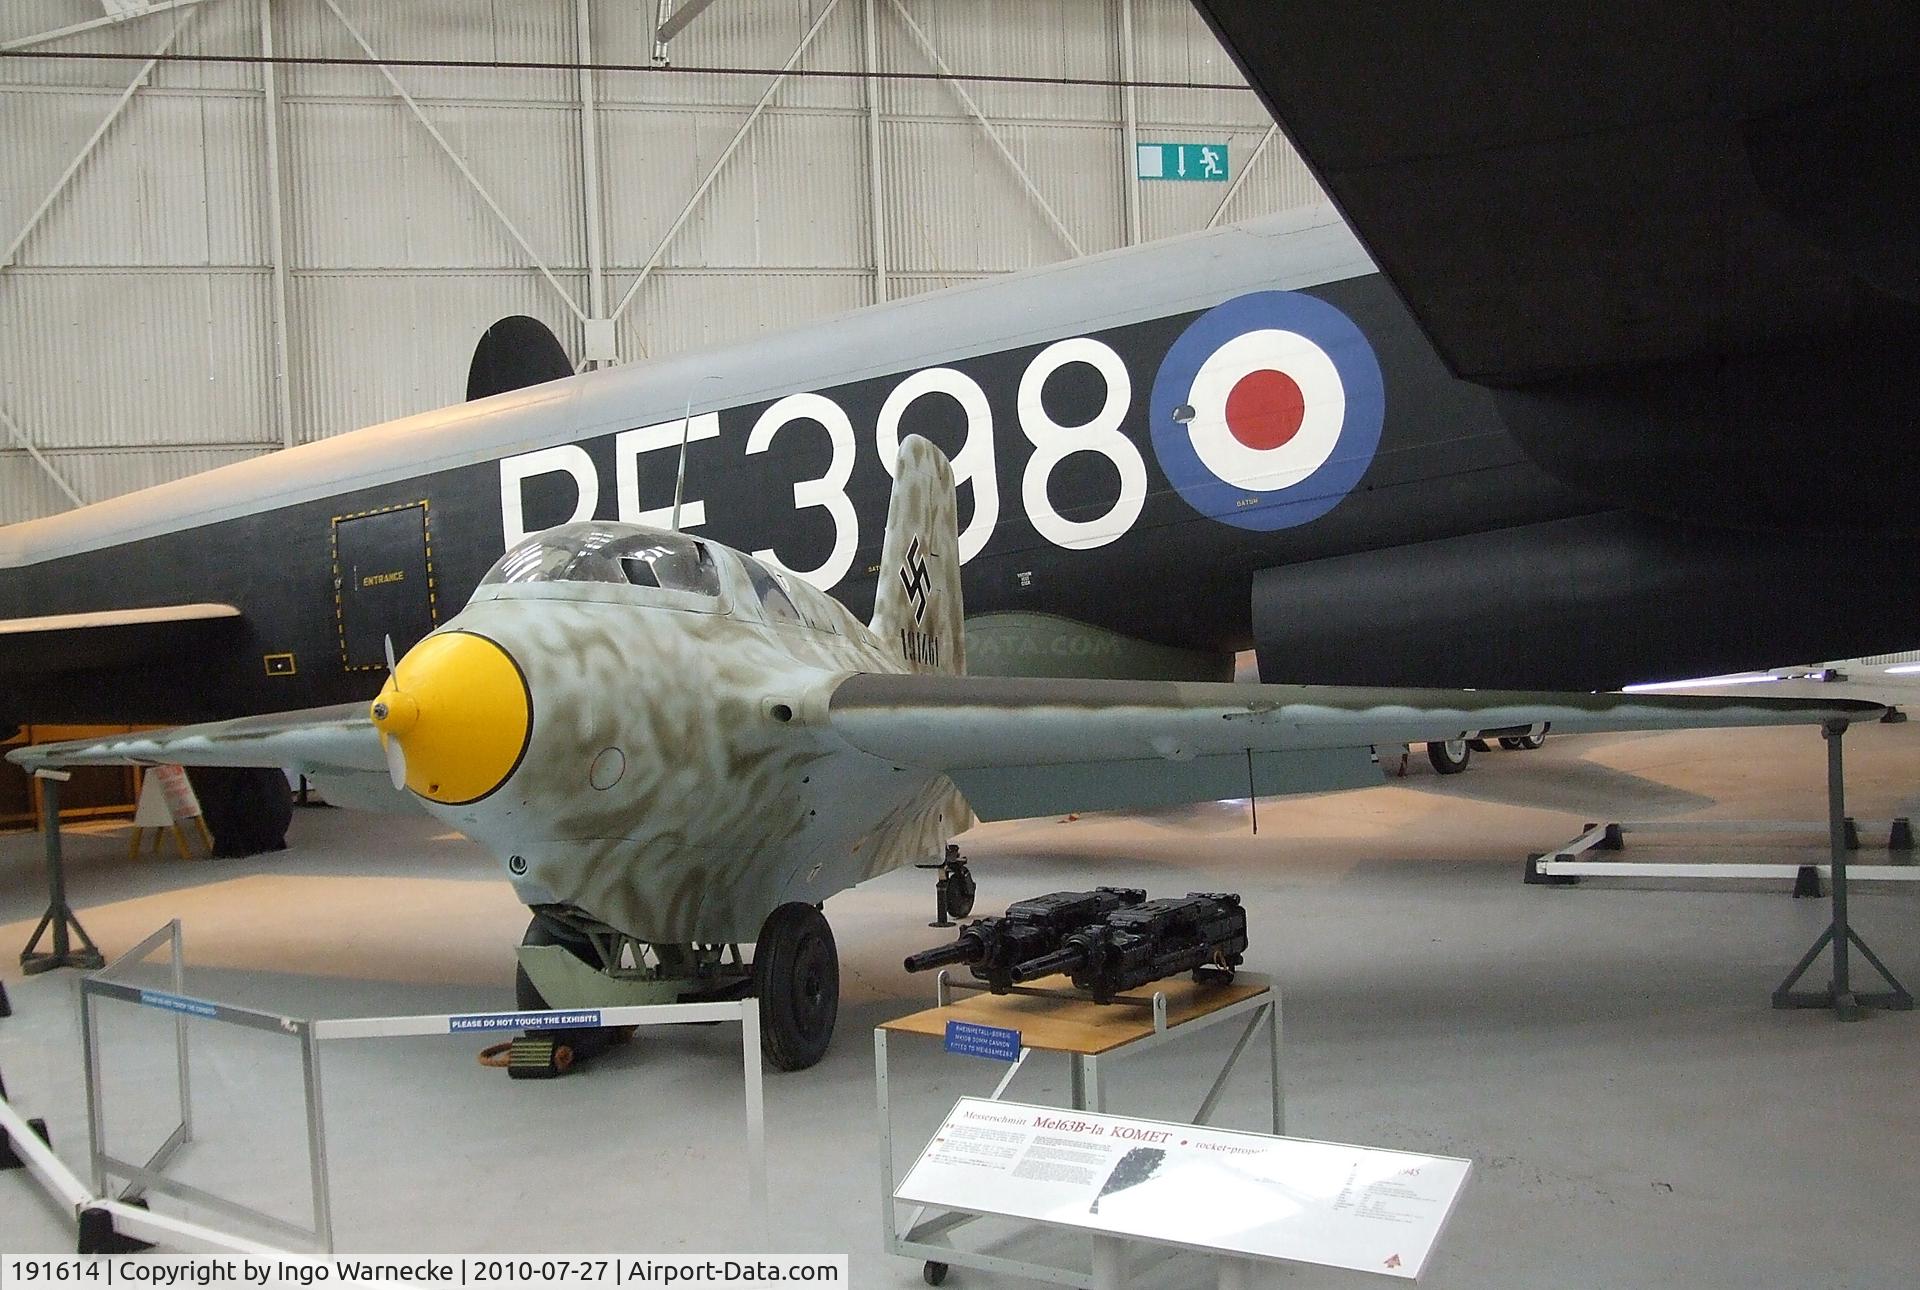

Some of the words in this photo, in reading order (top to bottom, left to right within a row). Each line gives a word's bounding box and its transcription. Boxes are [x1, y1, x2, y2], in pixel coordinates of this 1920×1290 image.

[363, 571, 404, 587] ENTRANCE
[452, 1020, 482, 1029] PLEASE
[483, 1019, 495, 1027] DO
[496, 1018, 513, 1026] NOT
[514, 1017, 542, 1026] TOUCH
[543, 1016, 560, 1025] THE
[561, 1015, 598, 1024] EXHIBITS
[1109, 1125, 1173, 1145] KOMET
